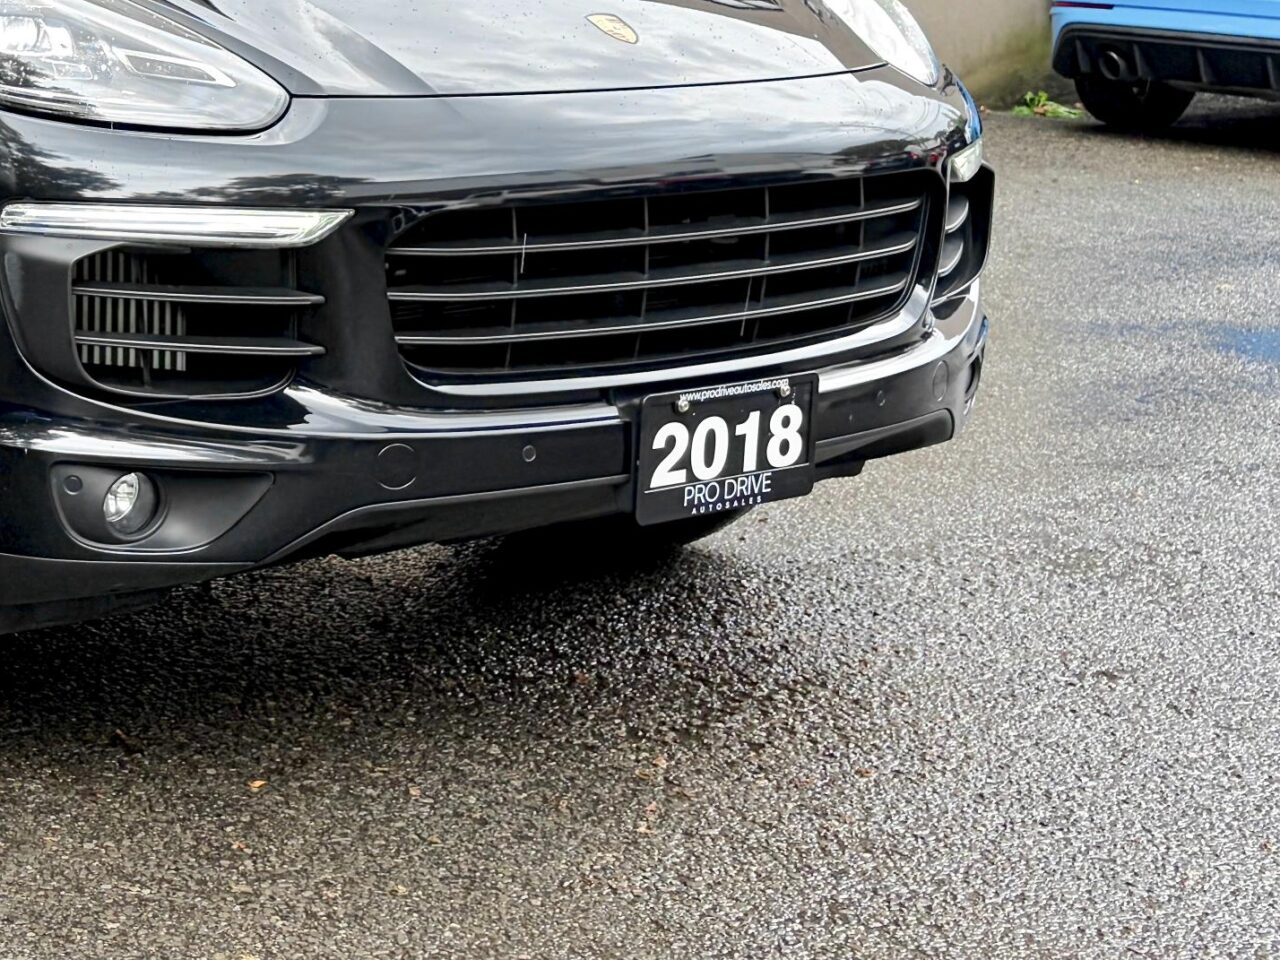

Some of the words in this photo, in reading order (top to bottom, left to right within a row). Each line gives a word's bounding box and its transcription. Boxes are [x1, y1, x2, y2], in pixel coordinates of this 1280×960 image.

[679, 379, 790, 402] www.prodriveautosales.com
[650, 404, 803, 488] 2018
[683, 481, 720, 507] PRO
[723, 472, 772, 500] DRIVE
[691, 495, 762, 515] AUTOSALES
